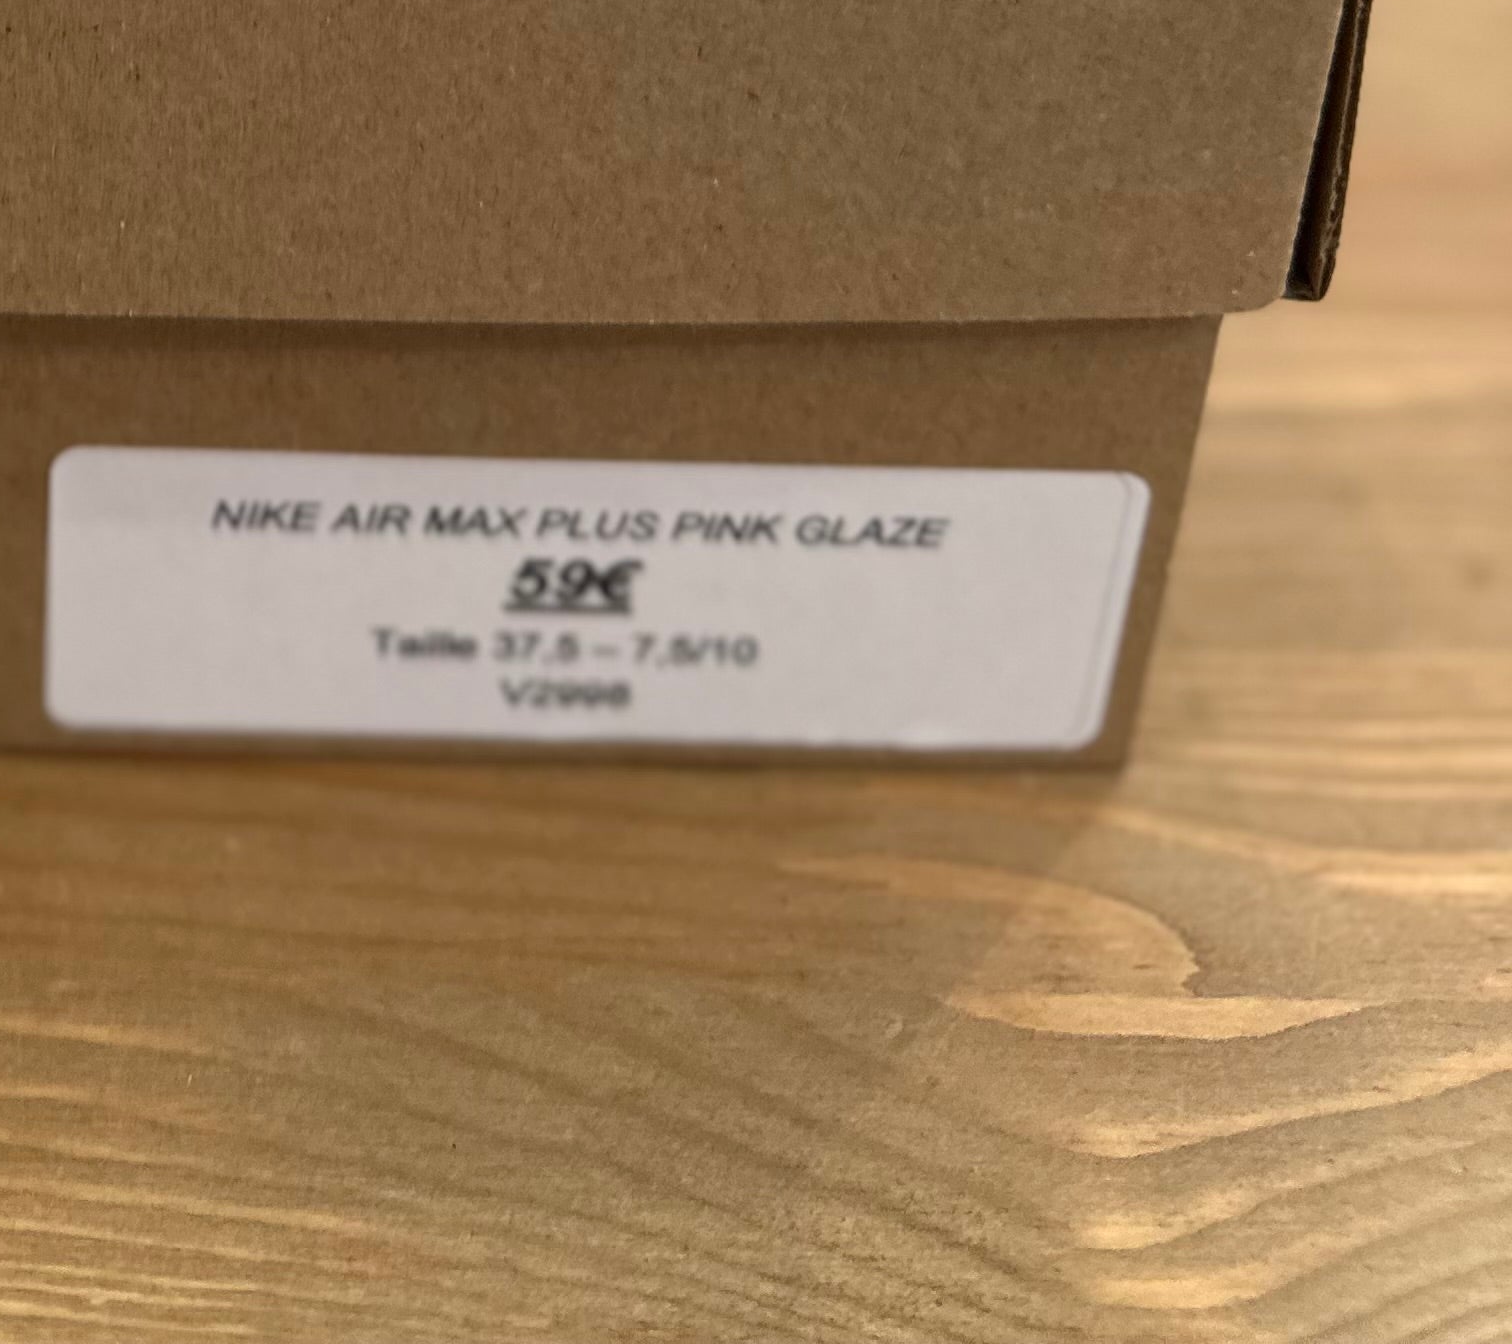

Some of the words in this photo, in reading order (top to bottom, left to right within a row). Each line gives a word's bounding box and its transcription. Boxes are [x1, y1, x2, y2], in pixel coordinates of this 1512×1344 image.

[212, 499, 322, 534] NIKE
[330, 503, 412, 536] AIR
[423, 505, 527, 539] MAX
[535, 507, 661, 542] PLUS
[670, 510, 783, 545] PINK
[794, 514, 950, 549] GLAZE
[502, 557, 644, 614] 59€
[373, 626, 479, 660] Taille
[492, 630, 581, 665] 37,5
[632, 632, 759, 669] 7,5/10
